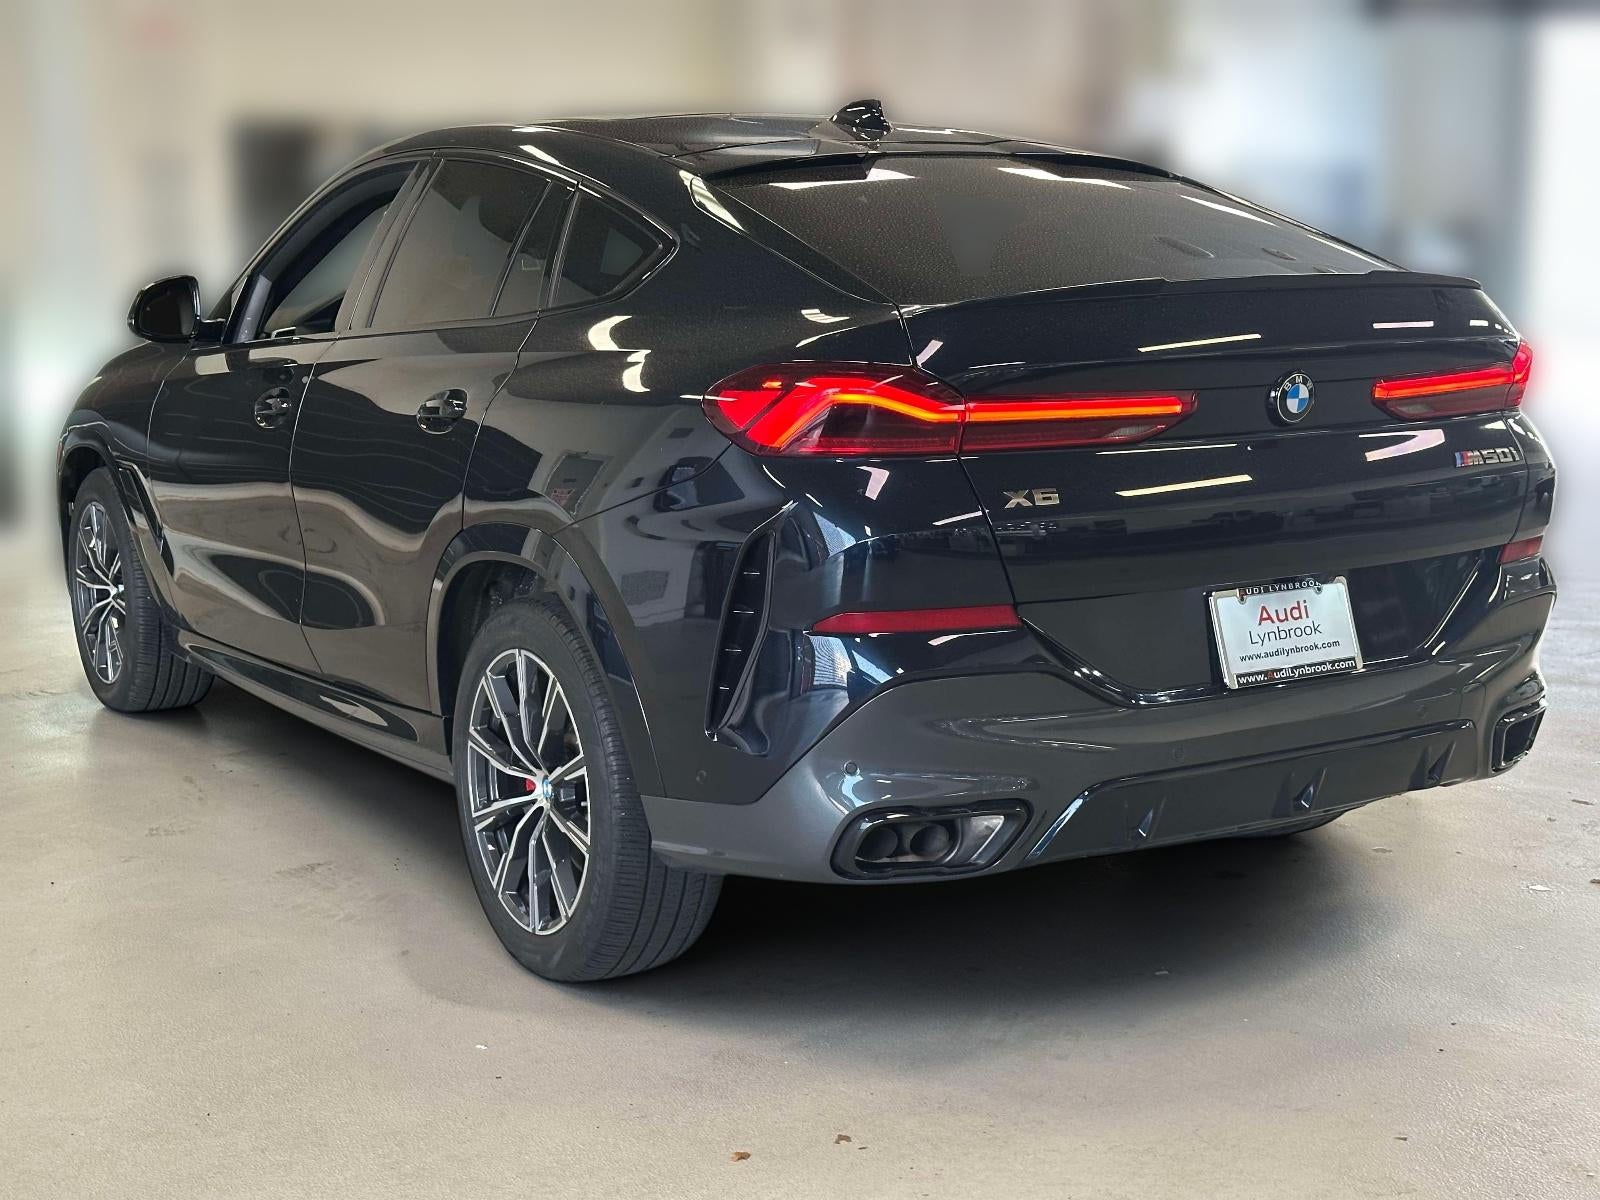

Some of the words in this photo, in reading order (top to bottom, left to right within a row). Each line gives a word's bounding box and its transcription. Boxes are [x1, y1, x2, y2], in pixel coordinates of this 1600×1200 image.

[1284, 376, 1313, 391] BMW
[1003, 488, 1060, 509] X6
[1259, 600, 1309, 625] Audi
[1249, 621, 1322, 646] Lynbrook
[1239, 639, 1340, 662] www.audilynbrook.com
[1238, 660, 1355, 684] www.AudiLynbrook.com
